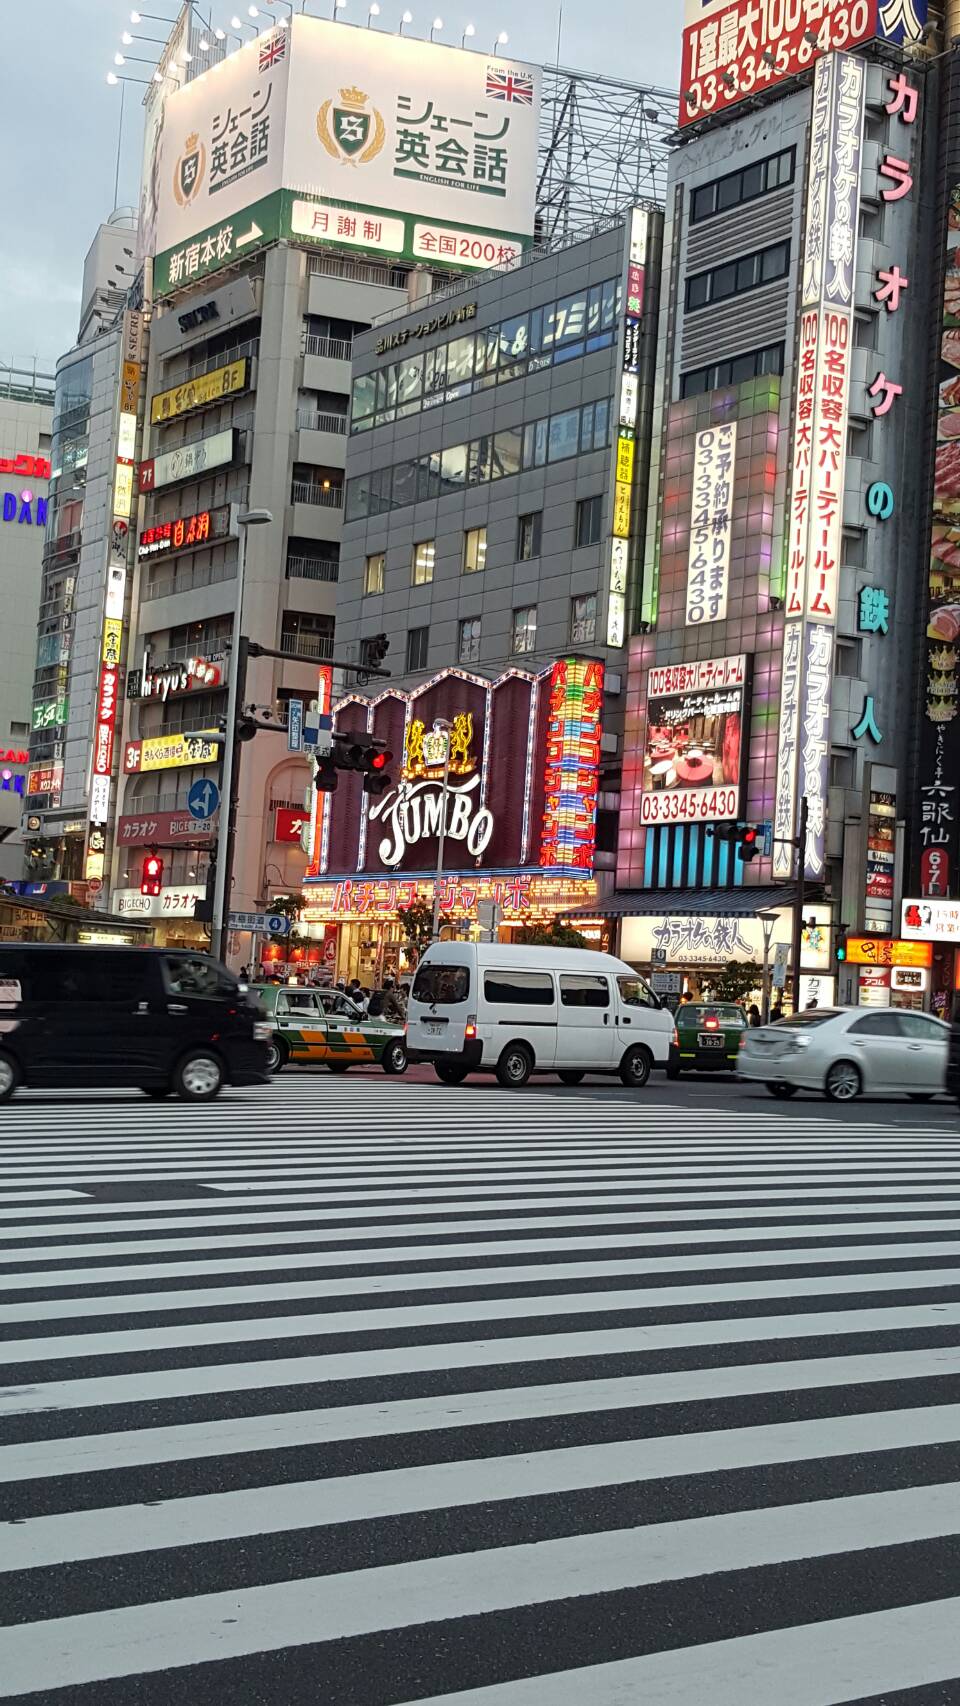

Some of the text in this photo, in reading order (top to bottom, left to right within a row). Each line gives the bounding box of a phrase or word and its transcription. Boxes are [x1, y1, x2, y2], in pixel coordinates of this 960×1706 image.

[686, 1, 869, 118] 03-3345-6430
[690, 0, 852, 82] 1室最大100名
[487, 65, 505, 76] From
[507, 69, 519, 78] the
[211, 82, 273, 145] シェーン
[396, 95, 511, 141] シェーン
[210, 115, 270, 183] 英会話
[394, 128, 509, 185] 英会話
[806, 55, 831, 300] カラオケの鉄人
[419, 174, 481, 192] ENGLISH FOR LIFE
[826, 57, 862, 303] カラオケの鉄人
[168, 225, 233, 284] 新宿本校
[311, 211, 382, 243] 月謝制
[418, 231, 517, 268] 全国200校
[620, 430, 633, 439] 4F
[787, 312, 819, 614] 100名収容大パーティールーム
[142, 467, 152, 485] 7F
[810, 313, 849, 616] 100名収容大パーティールーム
[687, 431, 715, 624] 03-3345-6430
[707, 424, 733, 620] ご予約承ります
[101, 673, 116, 720] カラオケ
[649, 658, 743, 695] 100名収容大パーティールーム
[540, 662, 568, 867] パチンコジャンボ
[573, 662, 604, 867] パチンコジャンボ
[774, 624, 800, 871] カラオケの鉄人
[803, 625, 830, 874] カラオケの鉄人
[122, 821, 158, 838] カラオケ
[374, 774, 494, 868] JUMBO
[920, 780, 956, 847] 六歌仙
[163, 893, 200, 911] カラオケ
[331, 875, 531, 913] パチンコ ジャンボ
[652, 918, 754, 957] カラオケの鉄人
[808, 977, 820, 1003] カラ
[864, 978, 885, 986] アコム
